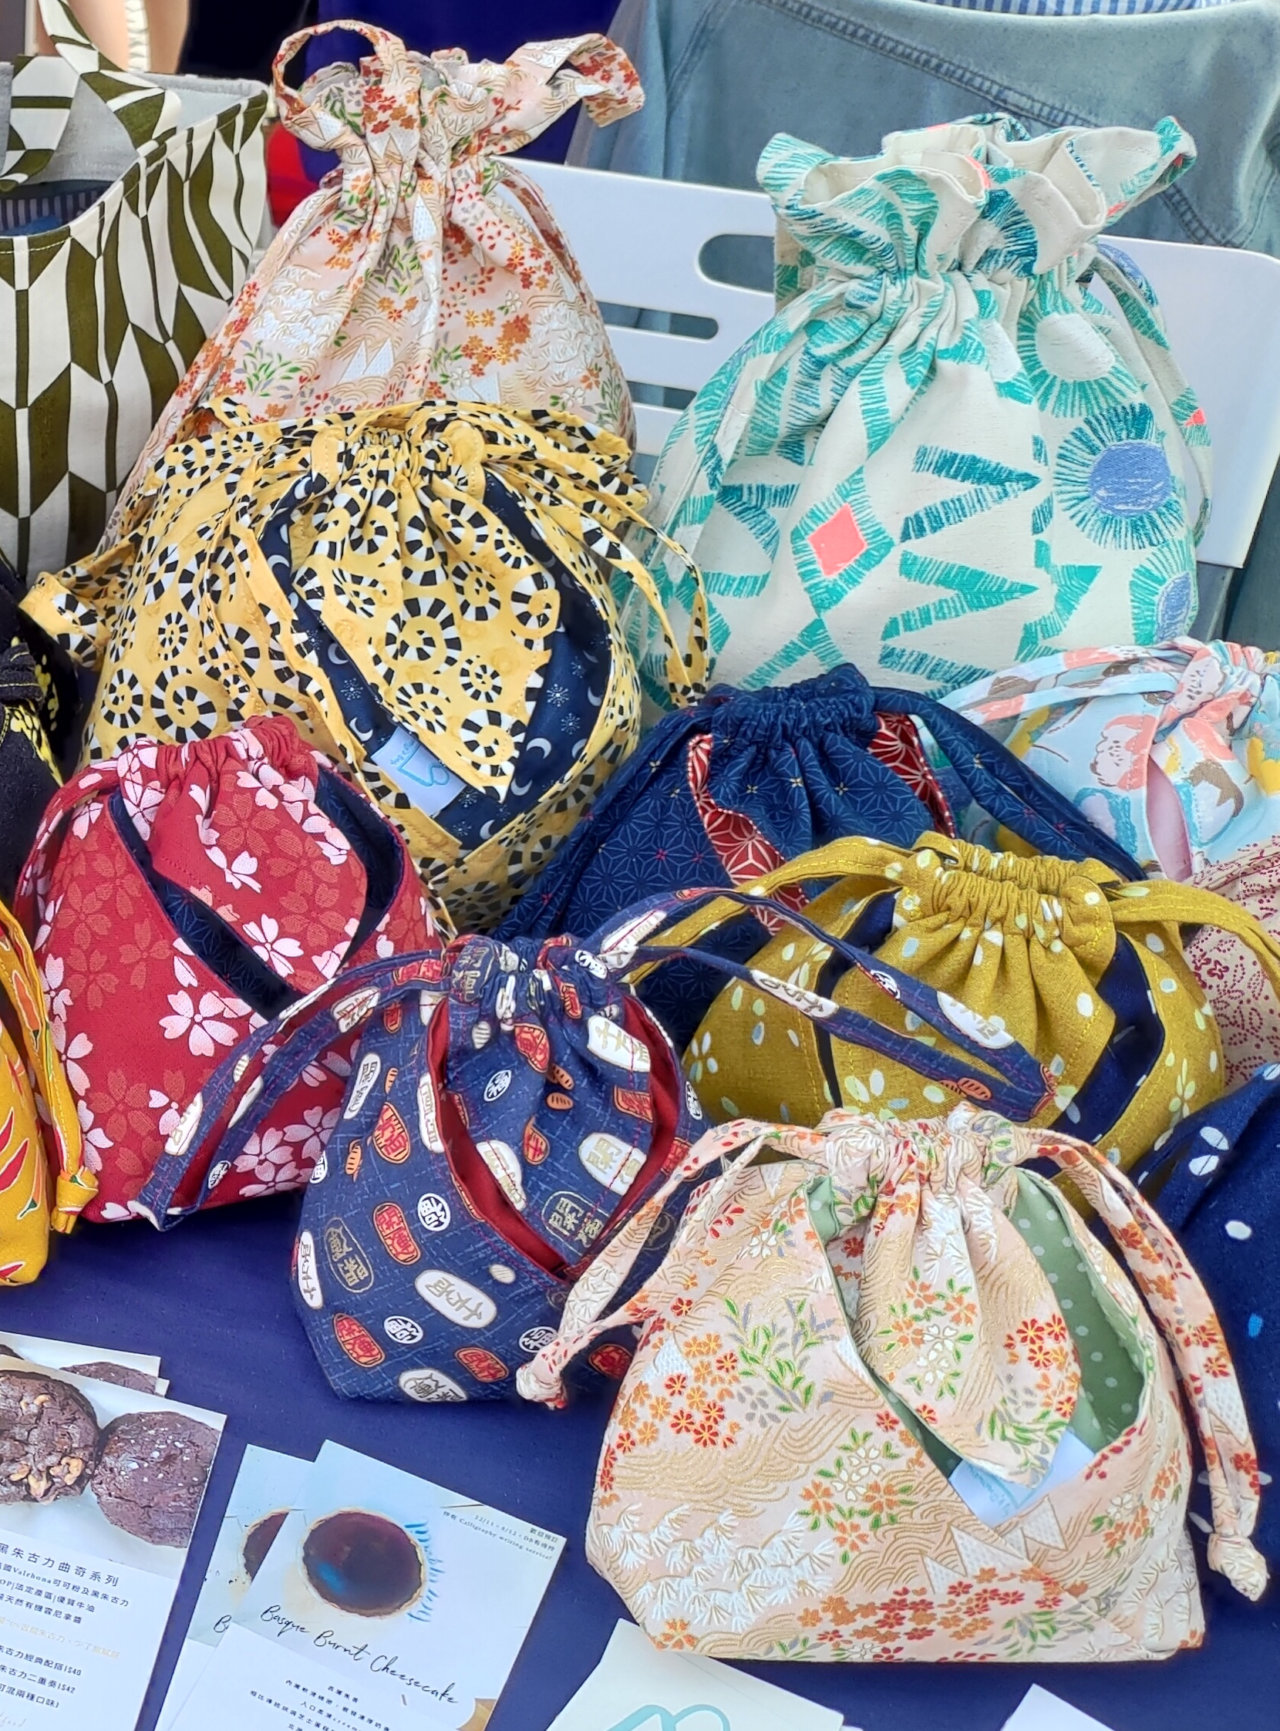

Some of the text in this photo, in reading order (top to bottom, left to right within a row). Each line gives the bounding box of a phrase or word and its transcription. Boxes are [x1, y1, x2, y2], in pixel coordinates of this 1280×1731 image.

[459, 1517, 496, 1538] Calligraphy
[499, 1536, 523, 1549] writing
[261, 1604, 310, 1637] Basque
[313, 1630, 372, 1661] Burnt
[369, 1654, 460, 1705] Cheesecake
